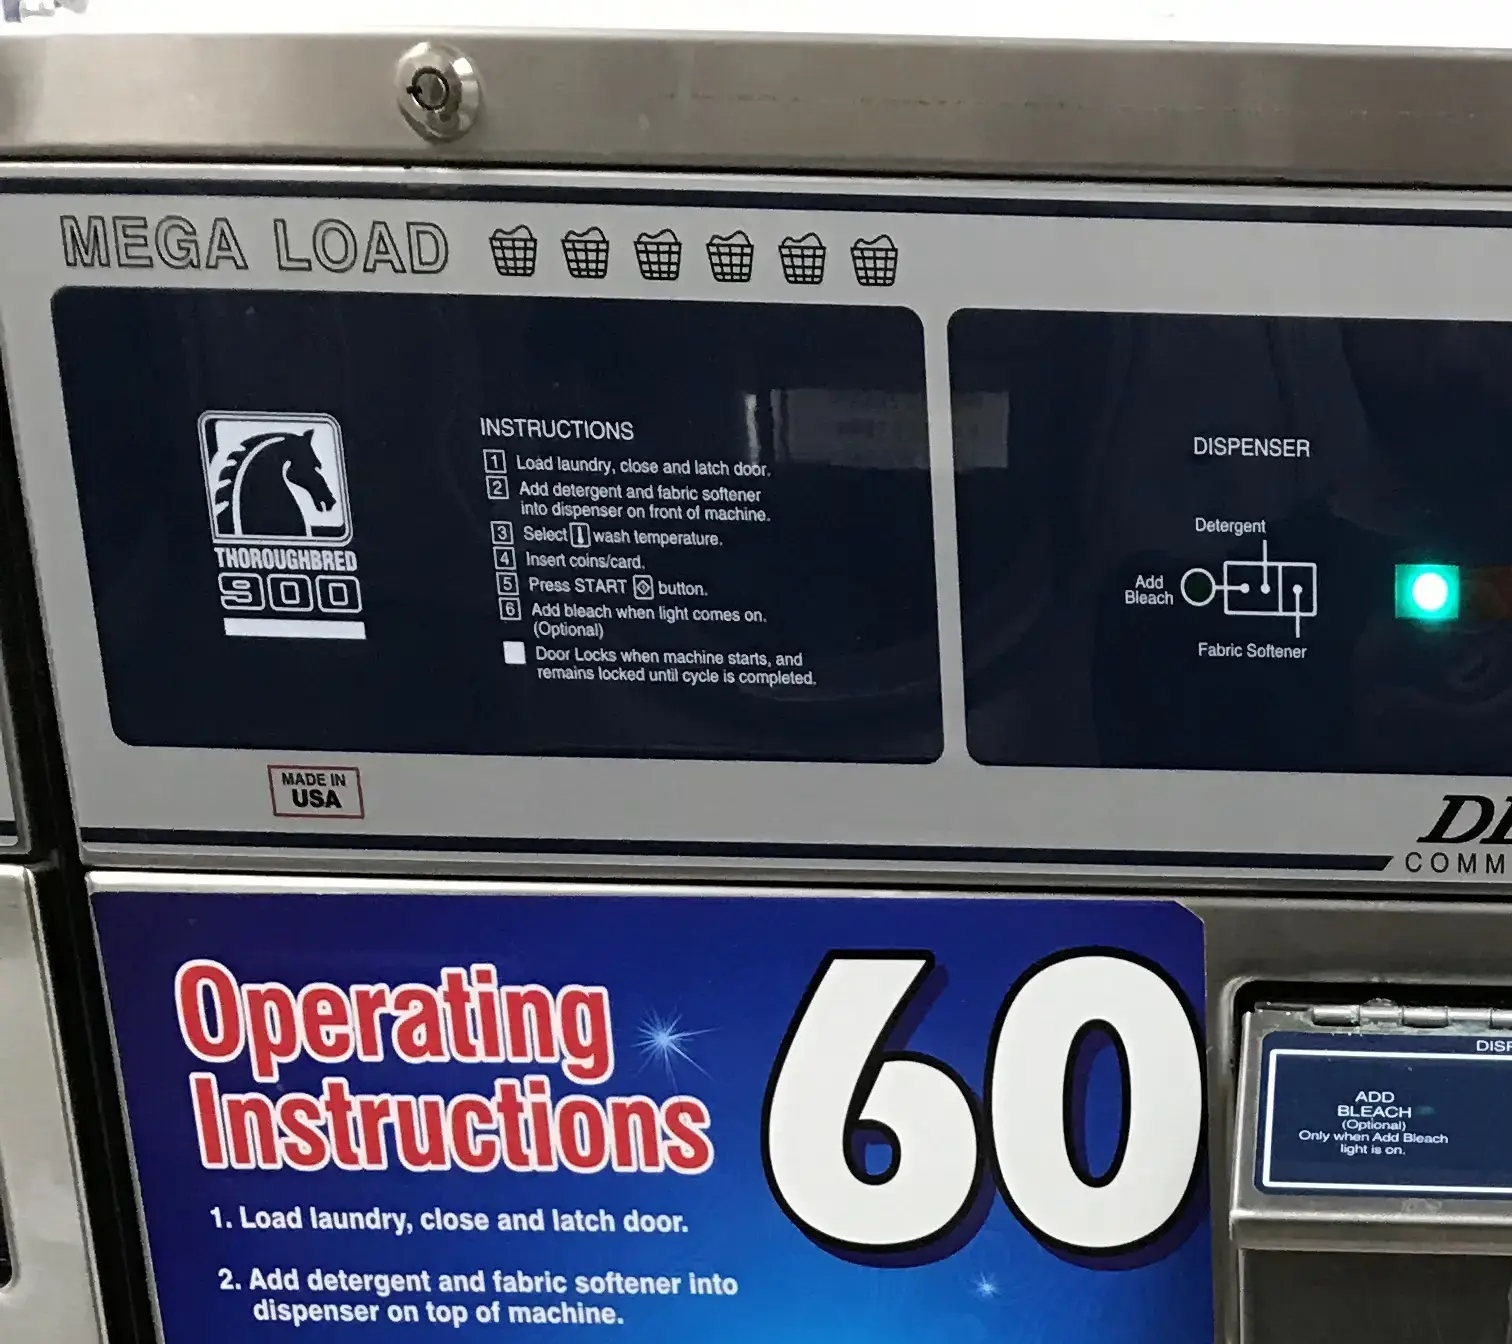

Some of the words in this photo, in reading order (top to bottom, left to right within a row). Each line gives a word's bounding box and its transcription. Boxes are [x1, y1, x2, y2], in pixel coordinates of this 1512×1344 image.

[59, 214, 249, 271] MEGA
[273, 218, 450, 275] LOAD
[479, 417, 635, 441] INSTRUCTIONS
[1193, 436, 1310, 458] DISPENSER
[516, 454, 554, 471] Load
[557, 456, 616, 476] laundry,
[619, 458, 659, 474] close
[662, 459, 691, 475] and
[694, 459, 730, 476] latch
[733, 460, 771, 477] door.
[523, 525, 568, 542] Select
[592, 529, 631, 544] wash
[633, 529, 723, 548] temperature.
[1195, 517, 1266, 537] Detergent
[213, 546, 358, 572] THOROUGHBRED
[525, 551, 567, 568] Insert
[569, 552, 646, 570] coins/card.
[217, 571, 363, 614] 900
[528, 577, 571, 594] Press
[574, 578, 628, 595] START
[657, 580, 708, 596] button.
[1134, 574, 1164, 590] Add
[1124, 589, 1174, 606] Bleach
[1198, 641, 1243, 658] Fabric
[1246, 642, 1308, 659] Softener
[281, 772, 327, 787] MADE
[330, 772, 347, 787] IN
[291, 788, 343, 809] USA
[175, 959, 612, 1083] Operating
[764, 950, 1204, 1251] 60
[1354, 1090, 1395, 1104] ADD
[1337, 1104, 1412, 1119] BLEACH
[189, 1071, 715, 1174] Instructions
[1341, 1117, 1407, 1132] (Optional)
[1298, 1129, 1331, 1143] Only
[1333, 1131, 1370, 1142] when
[1371, 1131, 1400, 1143] Add
[1402, 1132, 1449, 1144] Bleach
[1340, 1143, 1368, 1157] light
[1370, 1144, 1383, 1155] is
[1384, 1146, 1406, 1156] on.
[210, 1206, 233, 1229] 1.
[239, 1205, 303, 1229] Load
[309, 1206, 413, 1236] laundry,
[420, 1206, 490, 1231] close
[497, 1208, 545, 1232] and
[551, 1208, 616, 1232] latch
[623, 1209, 689, 1233] door.
[218, 1267, 242, 1290] 2.
[249, 1267, 300, 1291] Add
[307, 1268, 432, 1298] detergent
[438, 1269, 486, 1293] and
[491, 1269, 568, 1294] fabric
[574, 1270, 682, 1295] softener
[688, 1271, 739, 1296] into
[253, 1298, 380, 1328] dispenser
[387, 1304, 420, 1323] on
[425, 1300, 469, 1329] top
[475, 1300, 501, 1324] of
[507, 1301, 625, 1325] machine.
